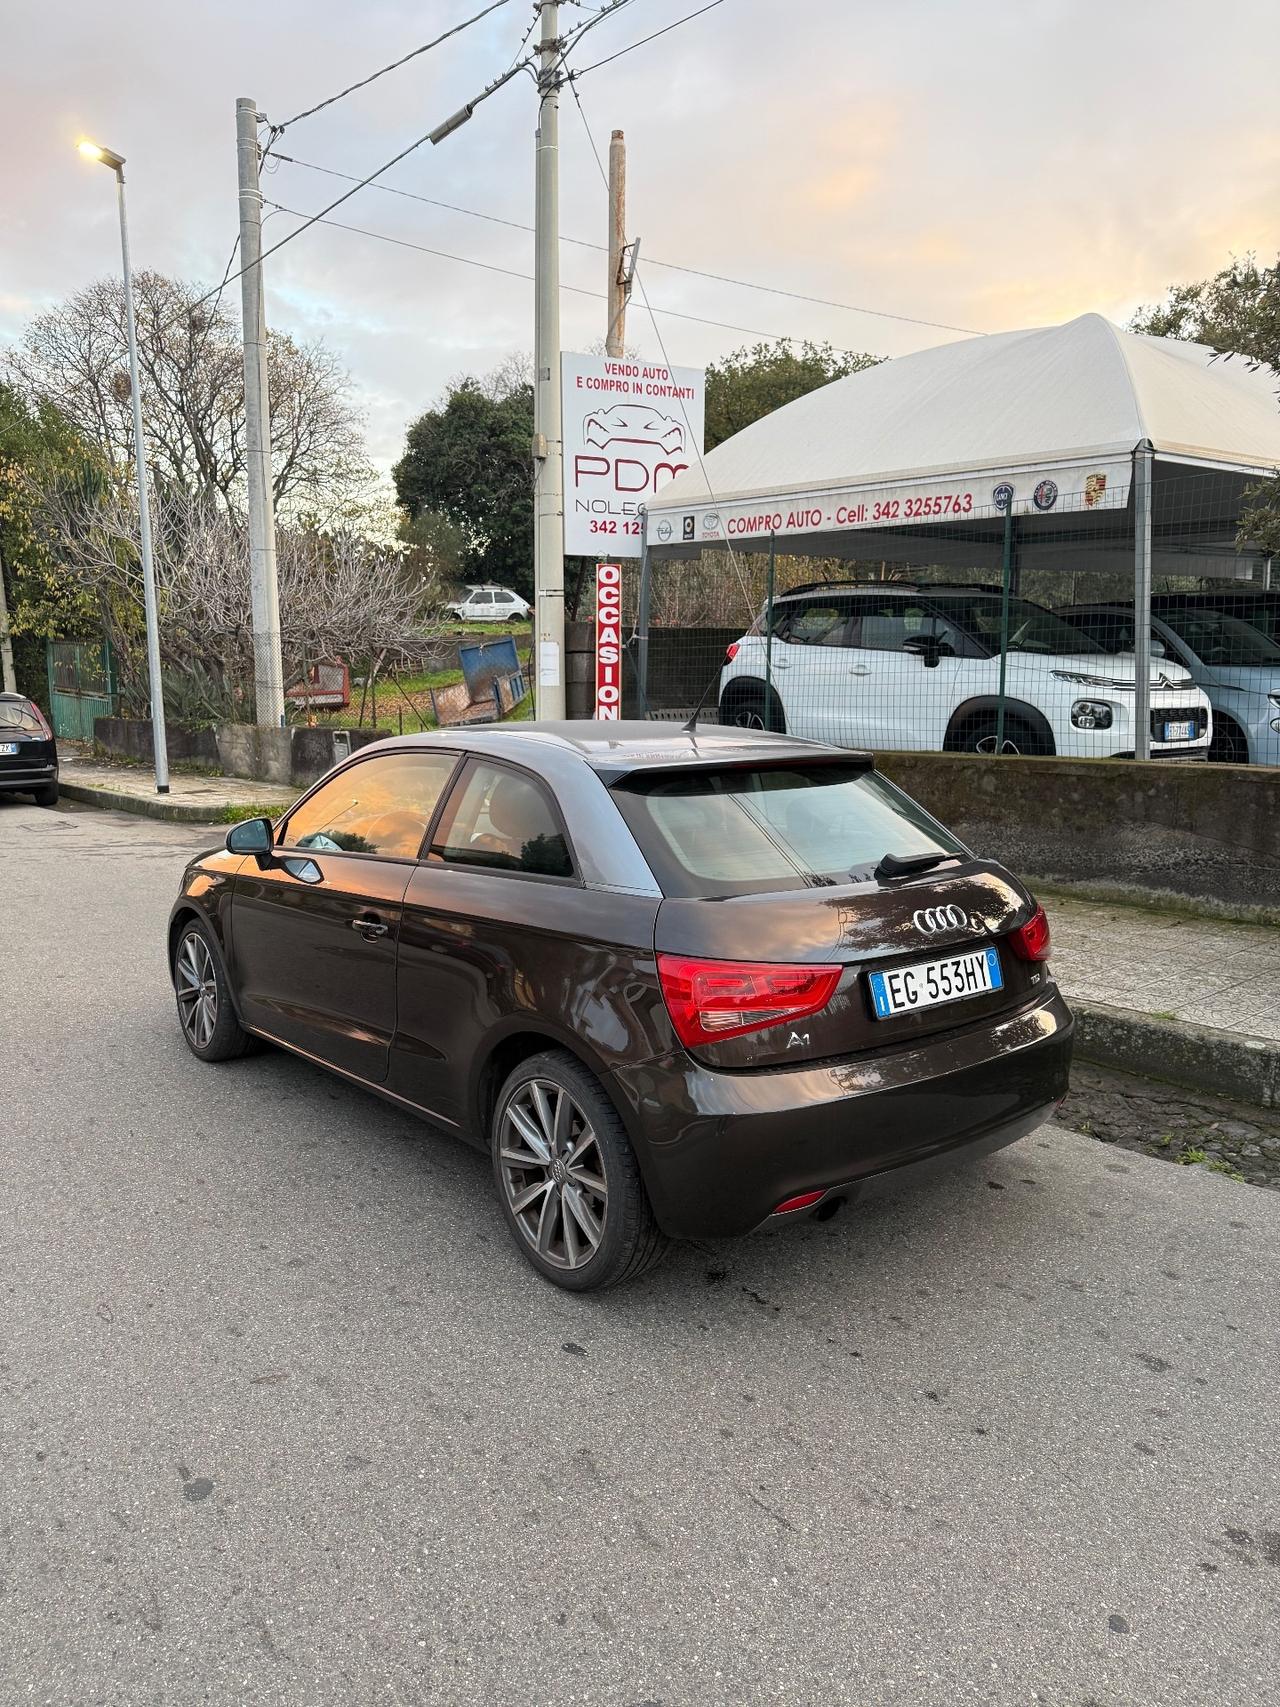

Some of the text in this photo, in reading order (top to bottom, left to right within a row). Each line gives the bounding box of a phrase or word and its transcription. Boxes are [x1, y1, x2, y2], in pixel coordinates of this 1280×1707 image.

[604, 362, 668, 380] VENDO AUTO
[576, 376, 695, 400] E COMPRO IN CONTANTI
[727, 513, 782, 534] COMPRO
[786, 509, 822, 528] AUTO
[836, 504, 868, 524] Cell:
[873, 500, 899, 520] 342
[904, 493, 973, 518] 3255763
[590, 520, 643, 535] 342 12
[888, 954, 988, 1009] EG 553HY
[786, 1031, 810, 1049] A1
